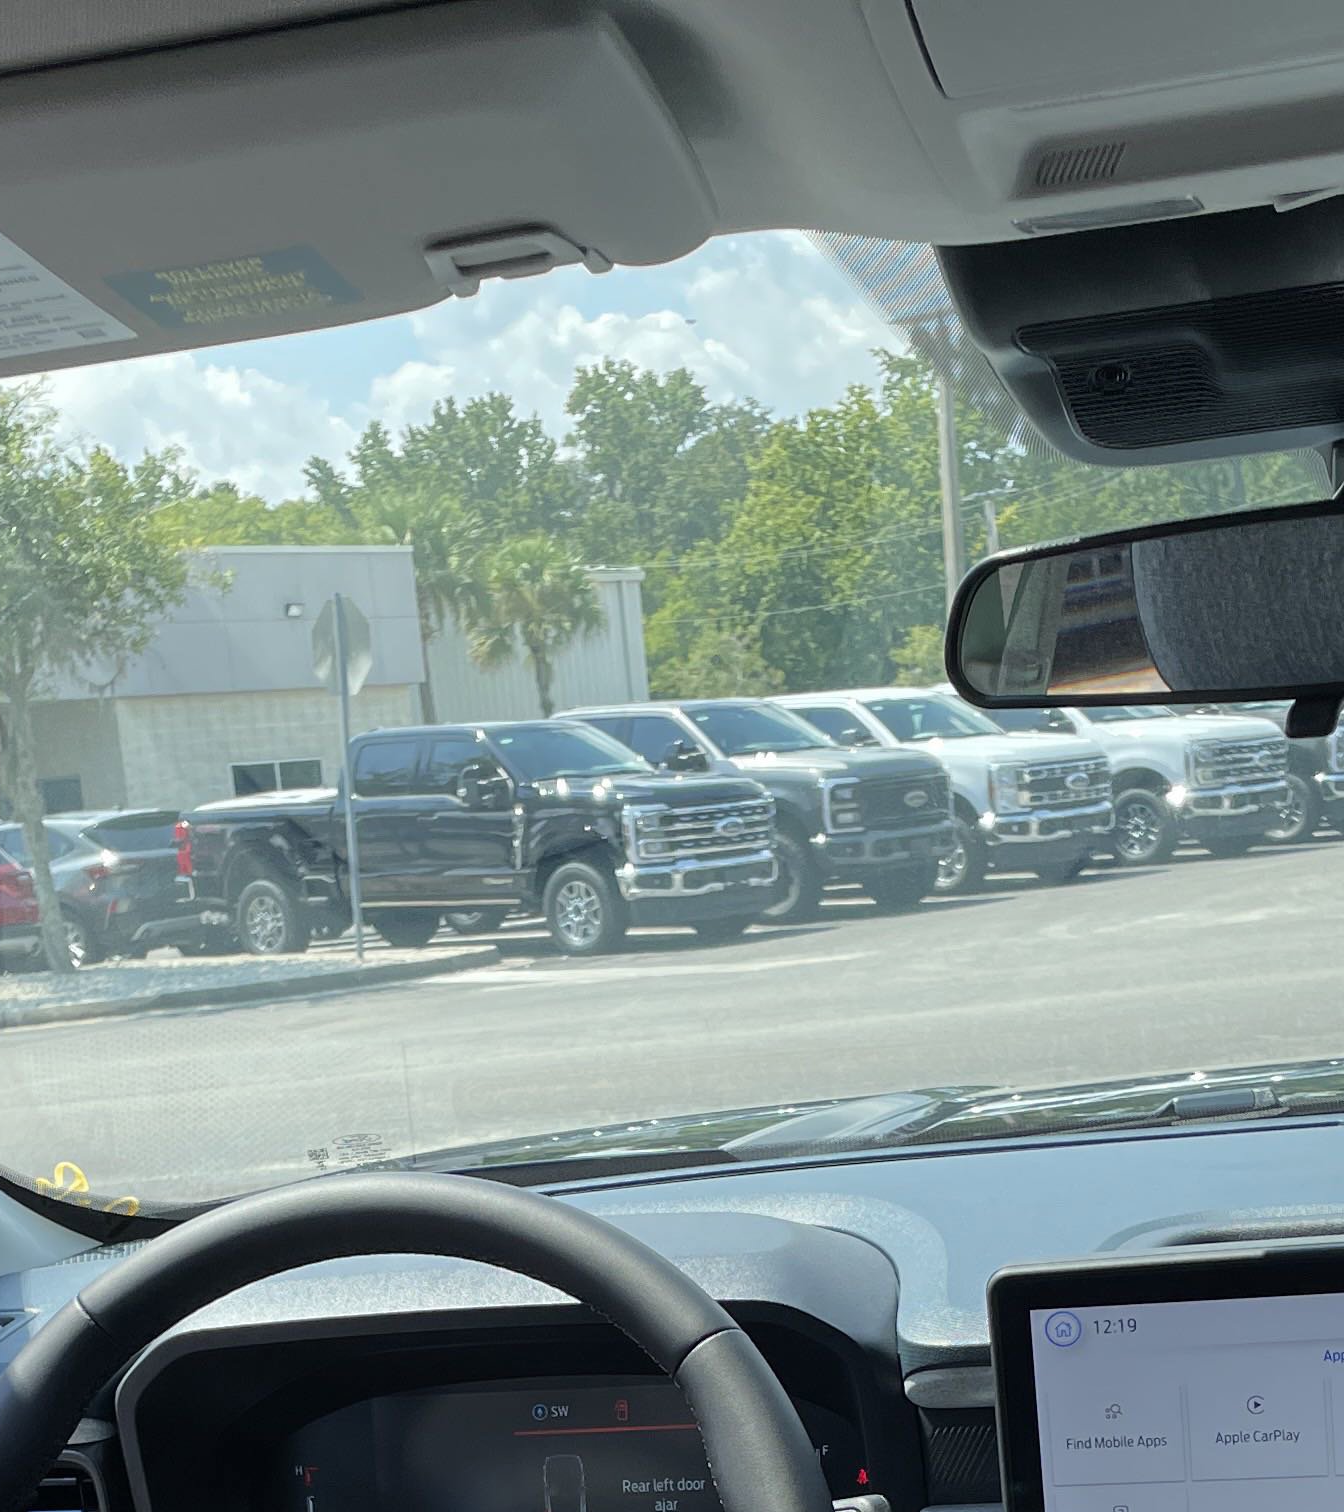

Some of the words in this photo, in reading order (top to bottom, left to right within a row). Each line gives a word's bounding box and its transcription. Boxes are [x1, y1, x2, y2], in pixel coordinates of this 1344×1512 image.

[1093, 1317, 1138, 1334] 12:19
[550, 1406, 569, 1418] SW
[1066, 1438, 1093, 1451] Find
[1094, 1435, 1135, 1449] Mobile
[1136, 1435, 1168, 1449] Apps
[1215, 1430, 1251, 1446] Apple
[1252, 1429, 1301, 1445] CarPlay
[622, 1479, 651, 1494] Rear
[652, 1477, 675, 1492] left
[676, 1477, 706, 1491] door
